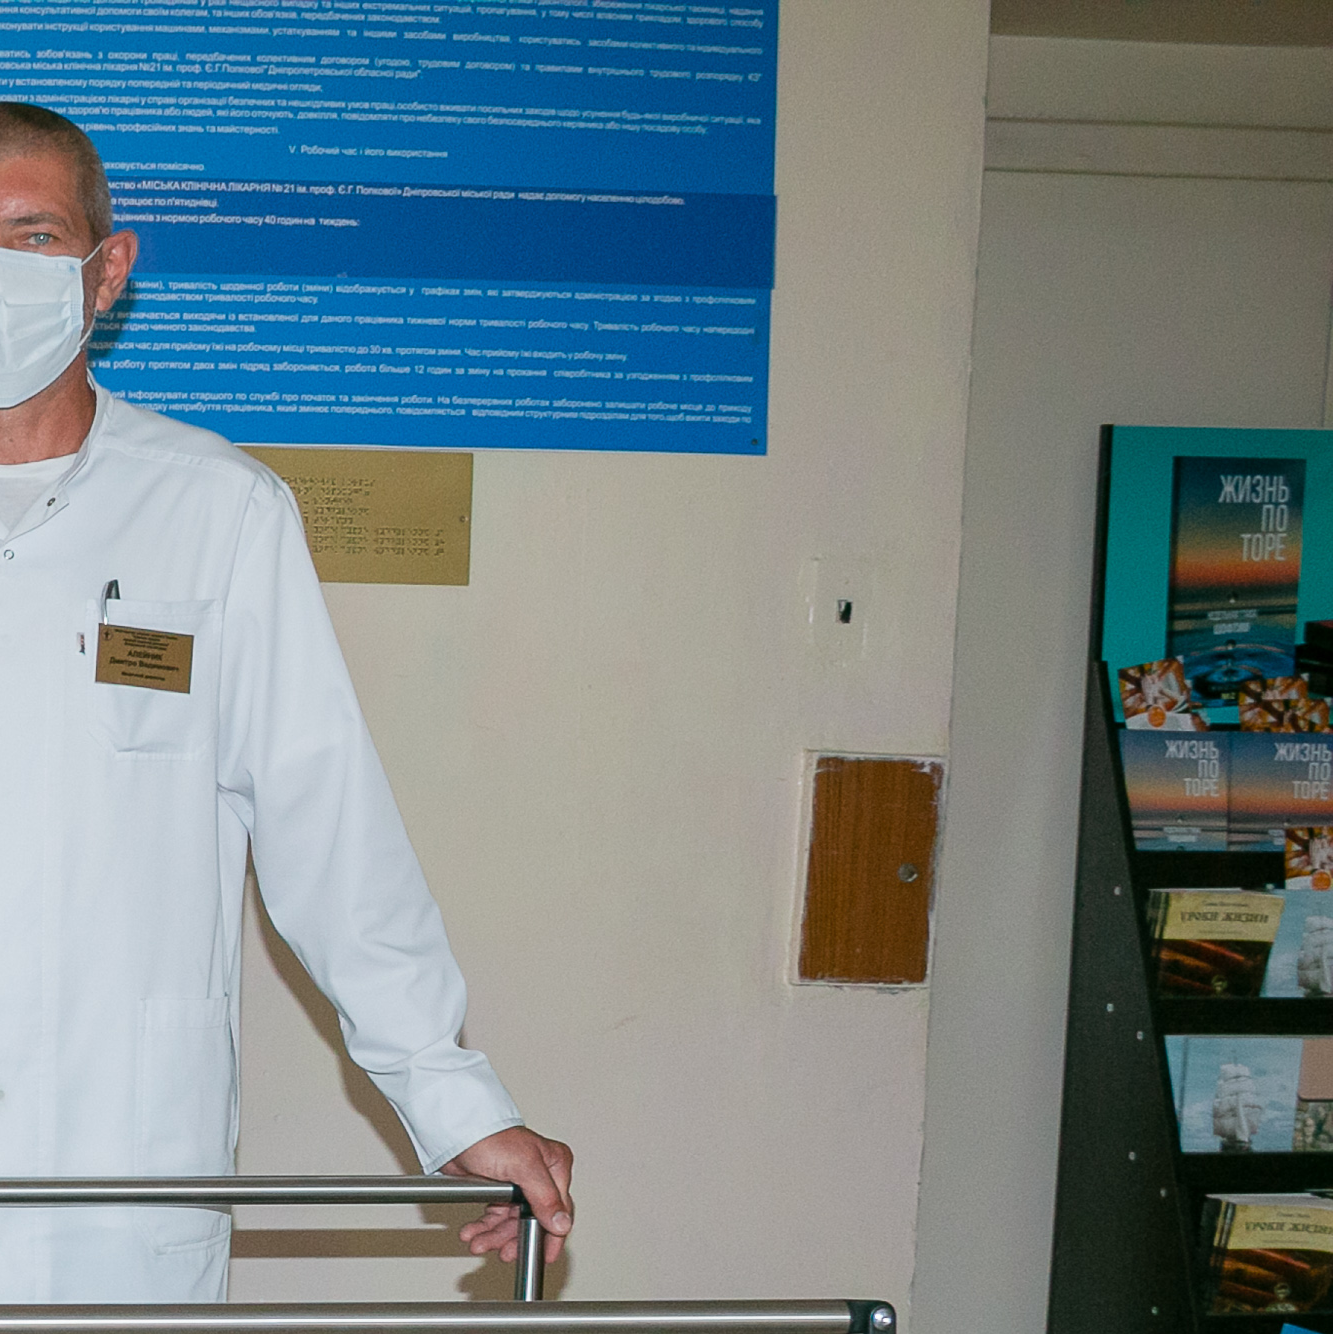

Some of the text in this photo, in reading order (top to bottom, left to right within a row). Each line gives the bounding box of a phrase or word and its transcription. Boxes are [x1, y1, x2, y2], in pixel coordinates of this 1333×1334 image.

[1218, 475, 1289, 503] ЖИЗНЬ
[1261, 504, 1289, 532] ПО
[1240, 533, 1287, 562] ТОРЕ
[1165, 740, 1219, 760] ЖИЗНЬ
[1275, 743, 1332, 762] ЖИЗНЬ
[1198, 760, 1219, 778] ПО
[1308, 762, 1331, 781] ПО
[1184, 778, 1219, 797] ТОРЕ
[1292, 781, 1331, 800] ТОРЕ
